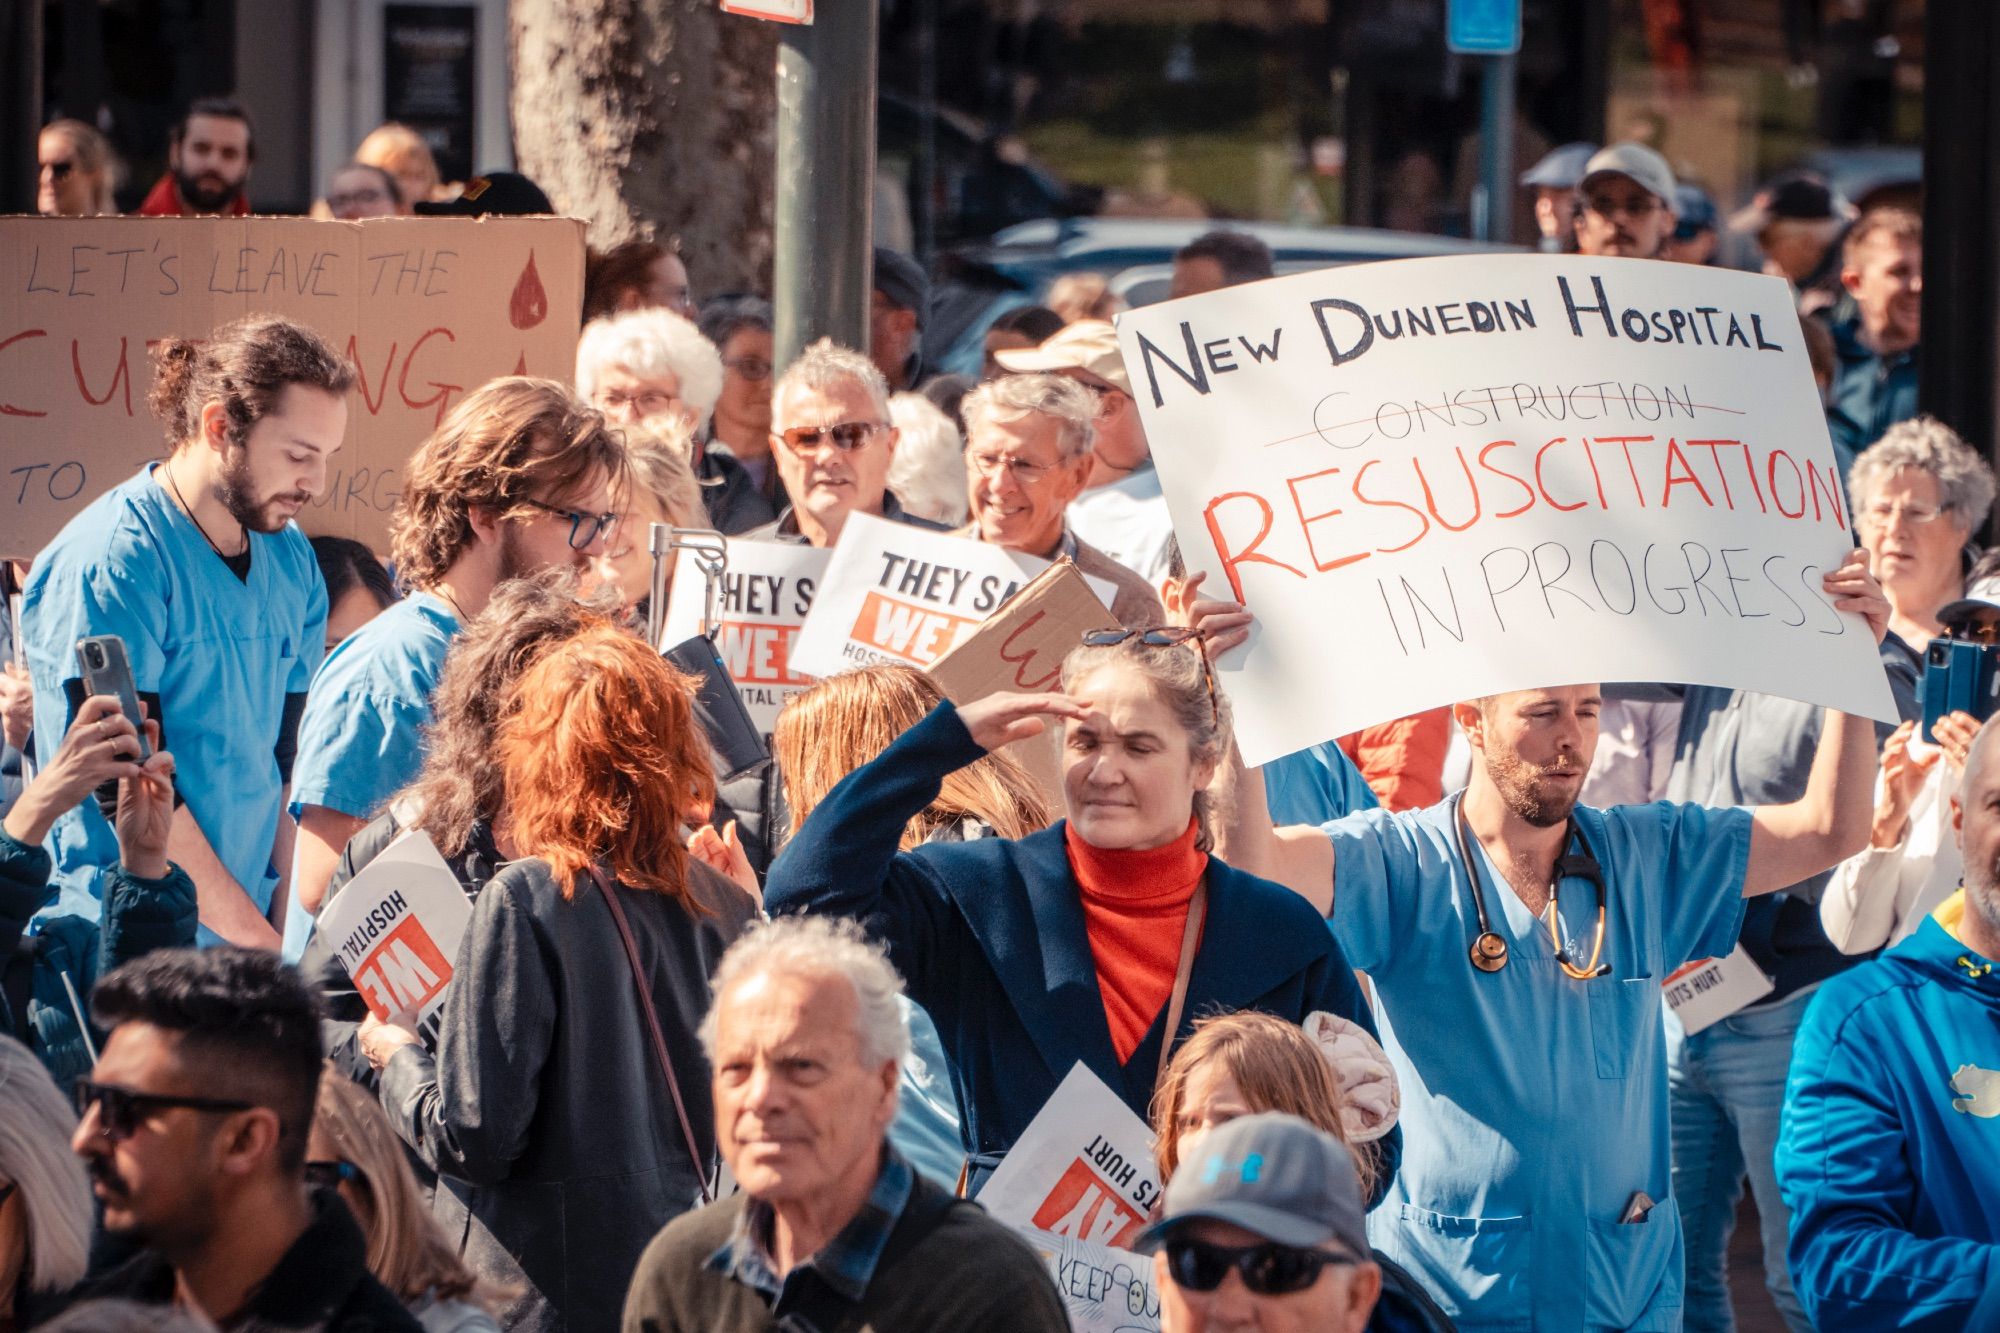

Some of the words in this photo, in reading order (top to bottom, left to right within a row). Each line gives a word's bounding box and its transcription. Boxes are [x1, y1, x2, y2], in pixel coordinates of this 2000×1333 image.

[27, 239, 180, 297] LET'S
[207, 246, 341, 298] LEAVE
[366, 250, 460, 298] THE
[0, 326, 464, 432] CUNG
[1312, 381, 1696, 449] CONSTRUCTION
[10, 460, 86, 505] TO
[1203, 435, 1847, 607] RESUSCITATION
[724, 572, 784, 616] HEY
[878, 551, 973, 607] THEY
[1377, 566, 1464, 656] IN
[1481, 539, 1845, 636] PROGRESS
[873, 598, 949, 661] WE
[342, 889, 409, 963] HOSPITAL
[360, 936, 441, 1025] WE
[1690, 965, 1724, 994] HURT
[1083, 1134, 1137, 1188] HURT
[1050, 1182, 1132, 1246] AY
[1132, 1179, 1161, 1212] TS
[1057, 1253, 1113, 1303] KEEP
